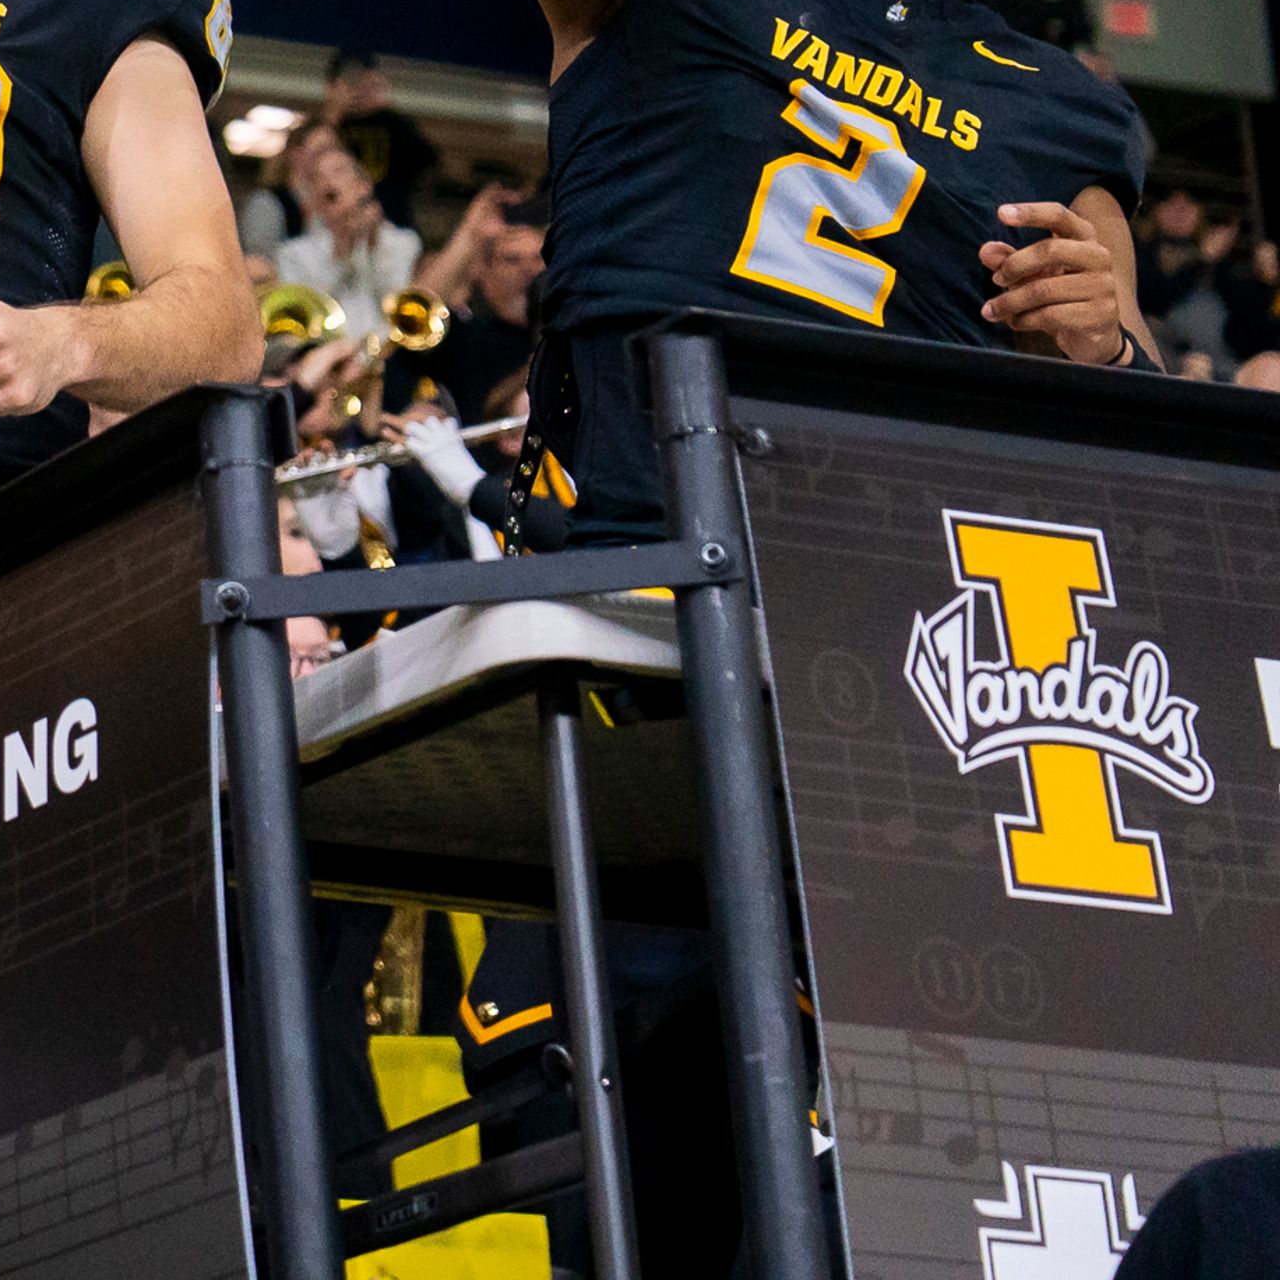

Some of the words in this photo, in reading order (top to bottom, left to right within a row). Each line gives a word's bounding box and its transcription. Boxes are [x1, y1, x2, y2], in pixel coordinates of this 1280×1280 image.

[770, 17, 982, 152] VANDALS
[730, 78, 927, 328] 2
[908, 595, 1210, 795] Vandals
